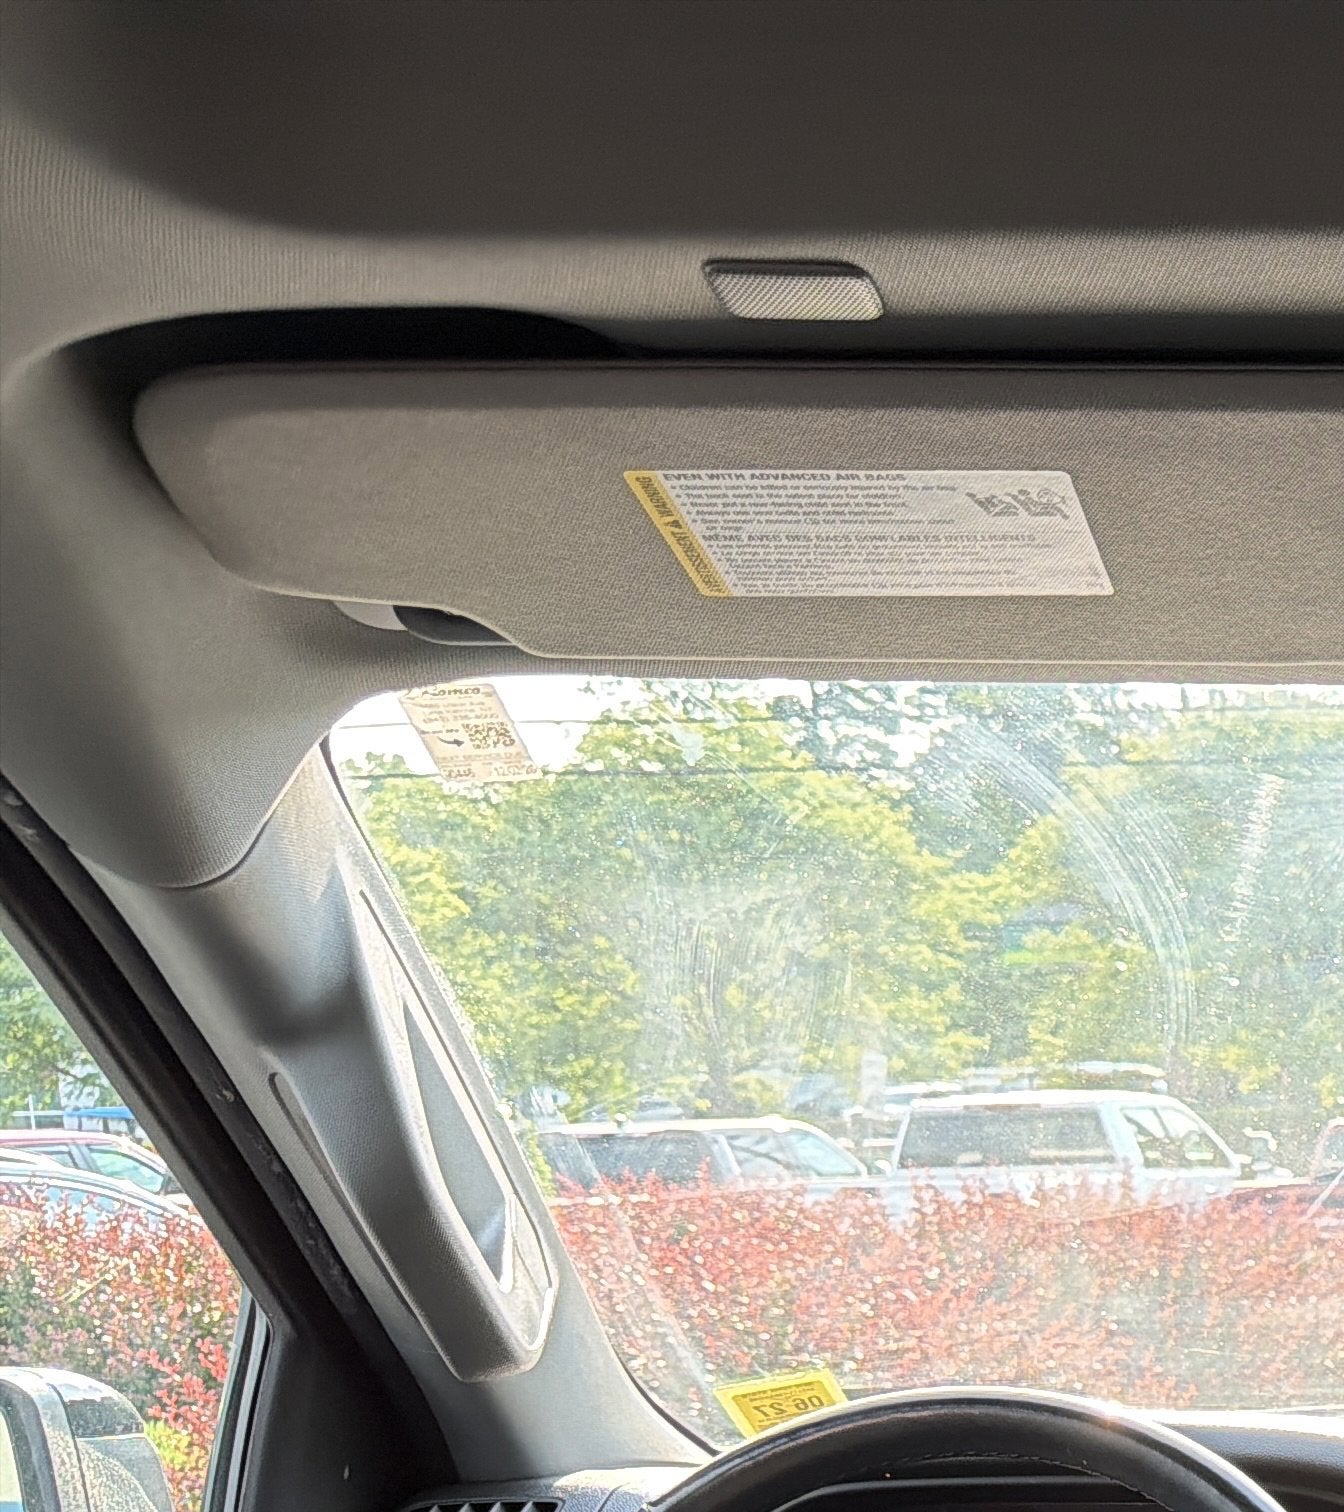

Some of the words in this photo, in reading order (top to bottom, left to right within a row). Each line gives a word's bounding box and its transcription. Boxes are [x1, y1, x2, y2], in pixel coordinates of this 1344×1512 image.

[663, 473, 701, 481] EVEN
[705, 473, 745, 481] WITH
[750, 473, 831, 481] ADVANCED
[836, 473, 860, 481] AIR
[864, 473, 907, 481] BAGS
[635, 475, 675, 518] WARNING
